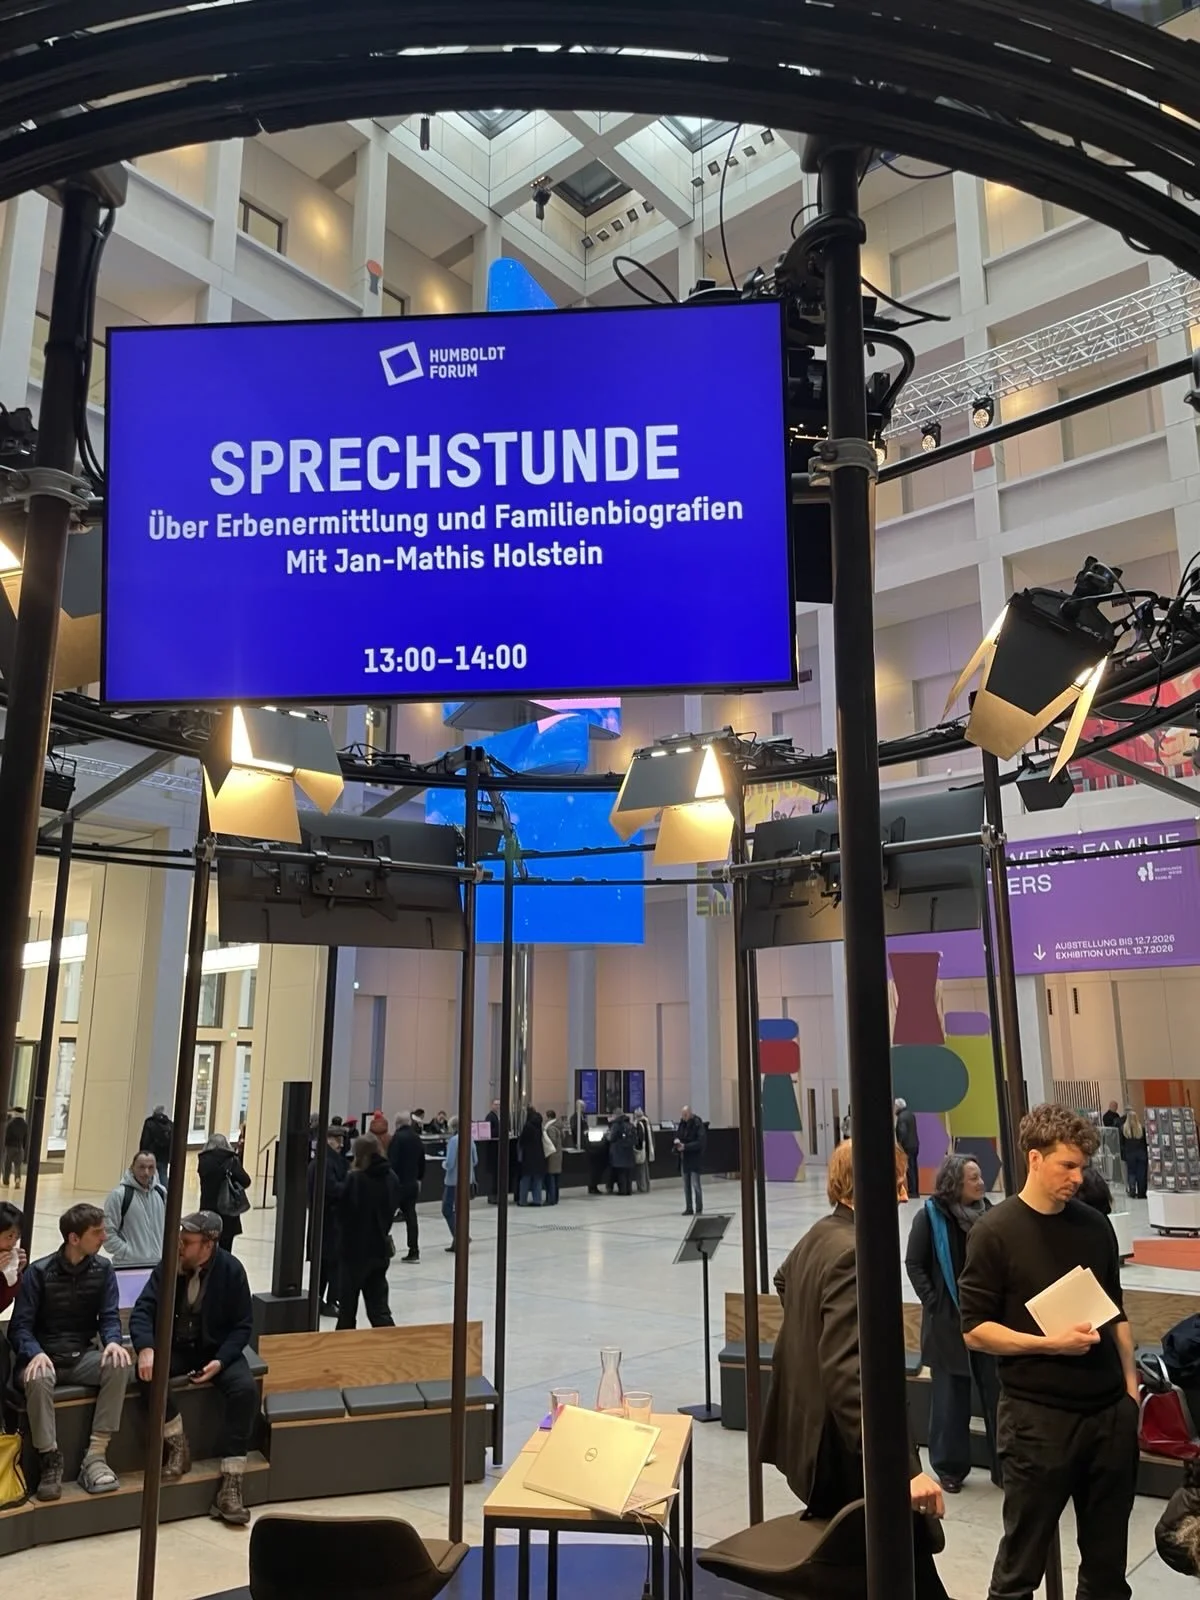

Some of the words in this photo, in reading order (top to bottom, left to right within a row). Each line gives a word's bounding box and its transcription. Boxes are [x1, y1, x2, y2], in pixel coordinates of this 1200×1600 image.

[429, 346, 506, 363] HUMBOLDT
[429, 363, 478, 379] FORUM
[210, 424, 680, 496] SPRECHSTUNDE
[148, 509, 209, 540] Über
[216, 505, 430, 539] Erbenermittlung
[437, 504, 486, 532] und
[495, 495, 743, 533] Familienbiografien
[286, 549, 328, 575] Mit
[334, 543, 485, 574] Jan-Mathis
[493, 539, 603, 569] Holstein
[987, 873, 1052, 896] ERS
[1055, 938, 1117, 950] AUSSTELLUNG
[1118, 936, 1133, 946] BIS
[1135, 934, 1175, 945] 12.7.2026
[1055, 949, 1104, 960] EXHIBITION
[1104, 947, 1131, 957] UNTIL
